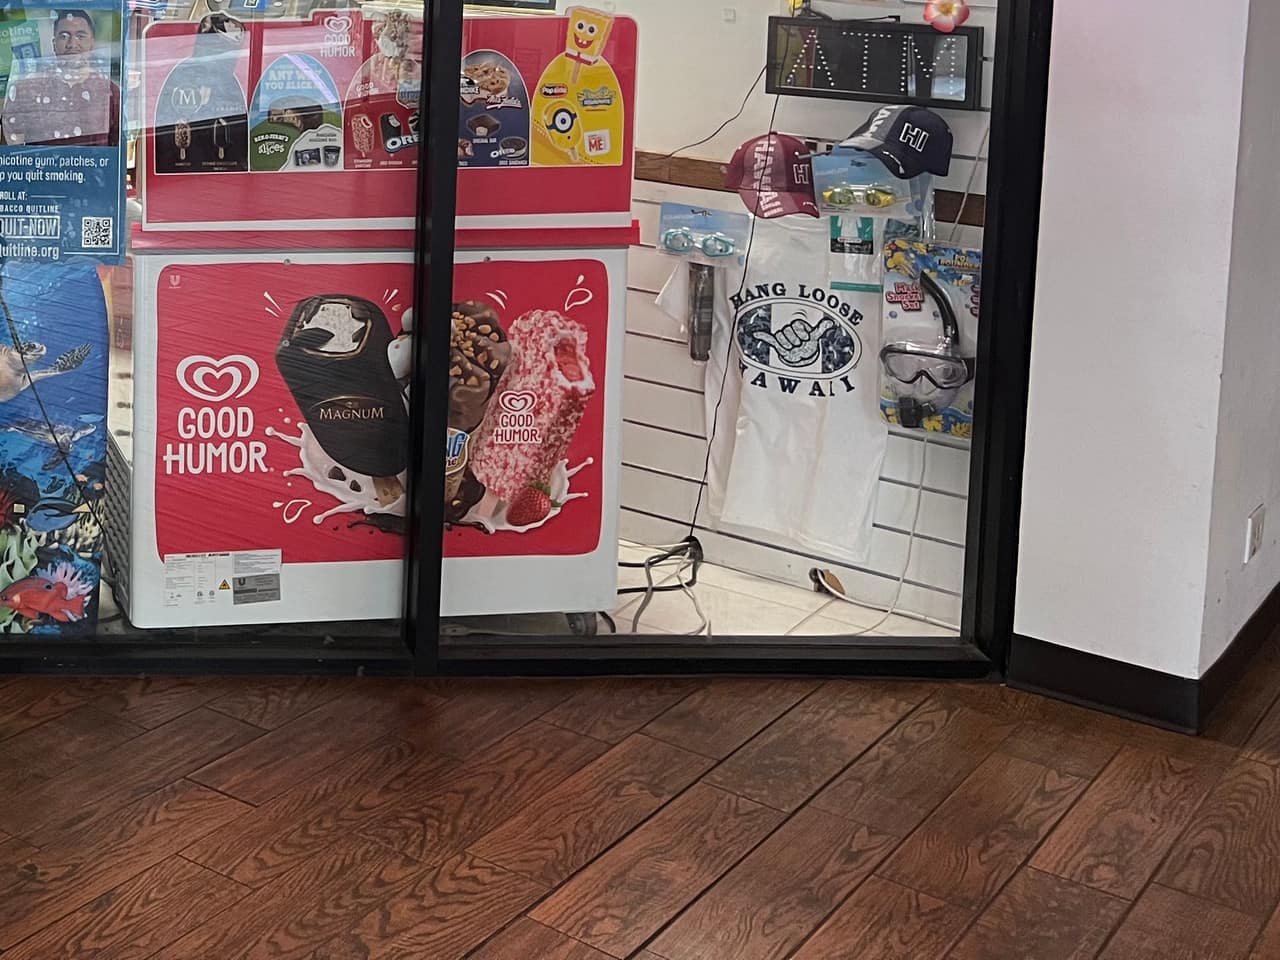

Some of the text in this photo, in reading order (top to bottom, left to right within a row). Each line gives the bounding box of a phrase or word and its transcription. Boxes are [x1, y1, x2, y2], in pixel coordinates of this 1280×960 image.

[324, 34, 351, 45] GOOD
[320, 46, 355, 57] HUMOR
[787, 29, 956, 95] ATM
[386, 135, 419, 149] ORE
[900, 123, 929, 153] HI
[588, 140, 604, 152] ME
[59, 156, 97, 168] patches,
[99, 158, 109, 167] or
[7, 172, 22, 182] you
[25, 170, 43, 182] quit
[45, 170, 86, 183] smoking.
[17, 192, 28, 201] AT:
[26, 205, 59, 214] QUITLINE
[729, 282, 863, 326] HANG LOOSE
[320, 407, 384, 421] MAGNUM
[501, 414, 533, 427] GOOD
[177, 407, 254, 439] GOOD
[495, 429, 538, 442] HUMOR
[163, 442, 269, 474] HUMOR
